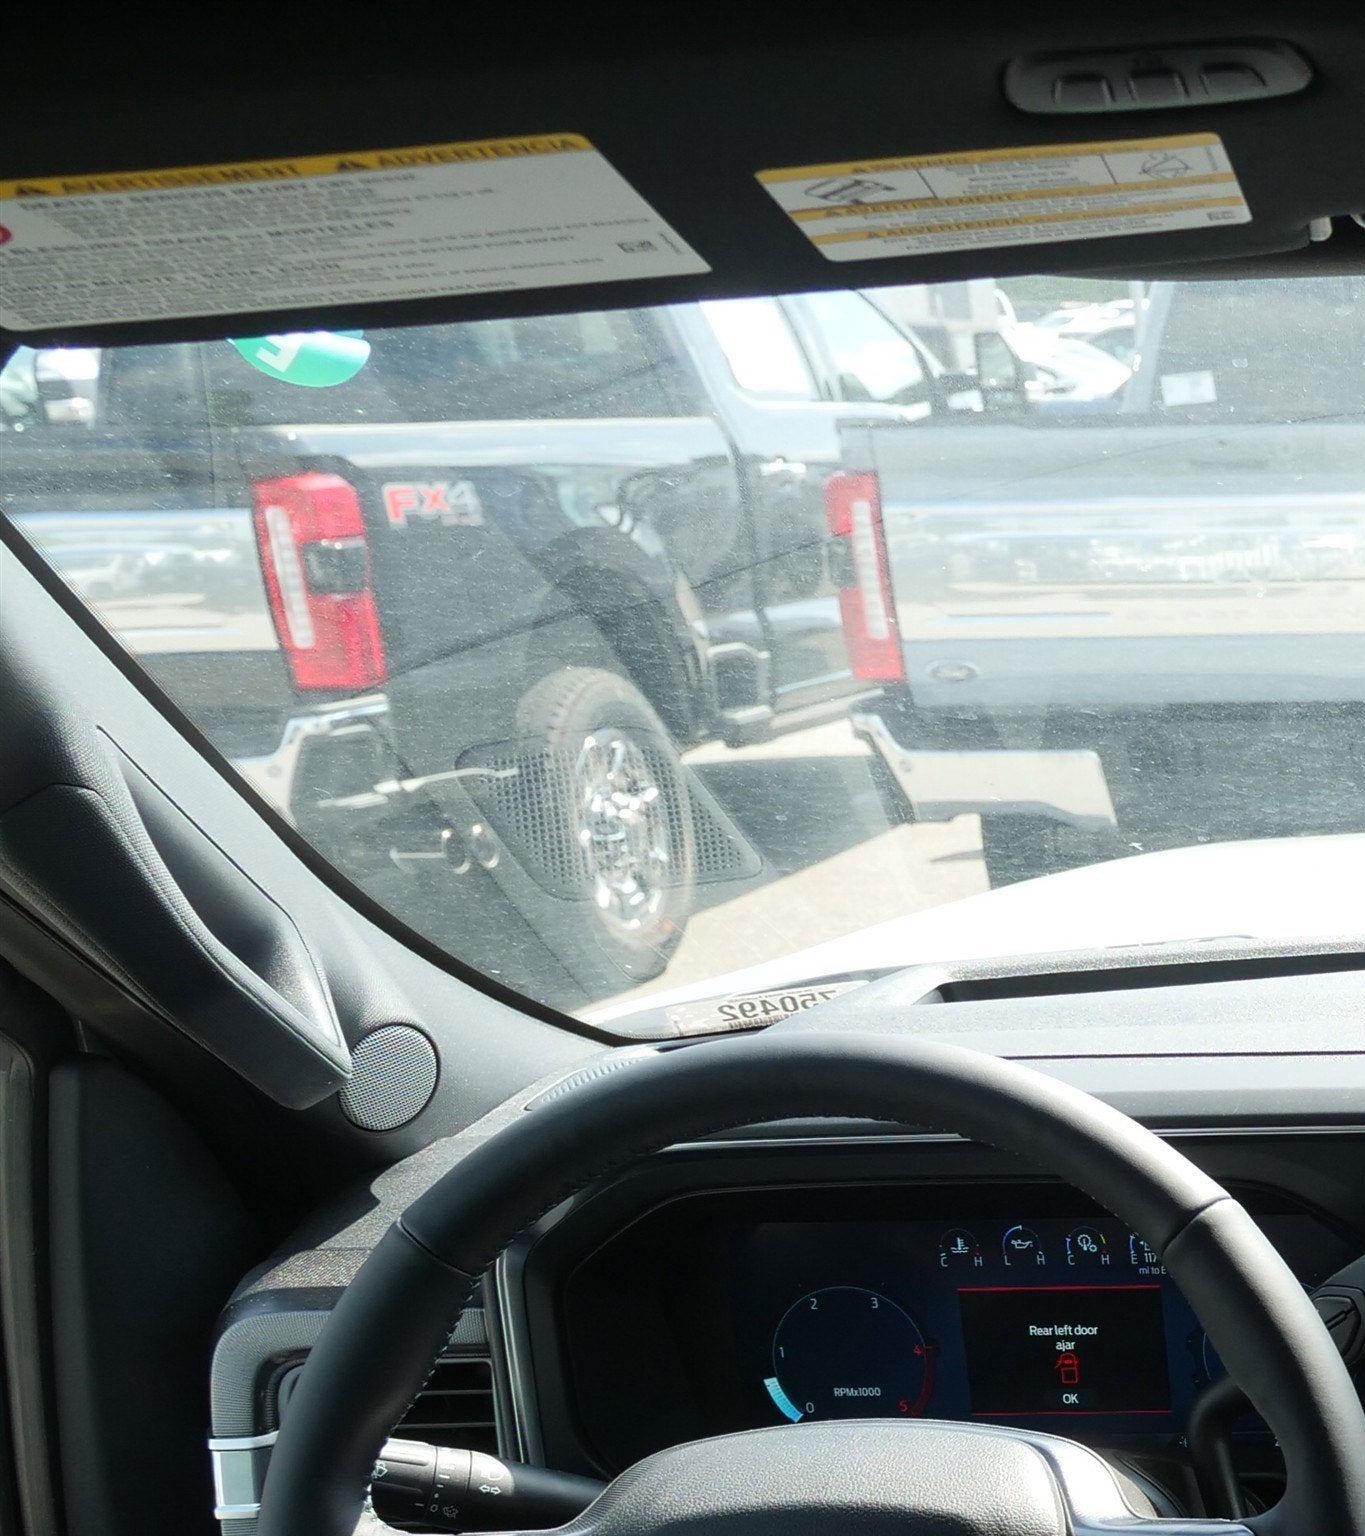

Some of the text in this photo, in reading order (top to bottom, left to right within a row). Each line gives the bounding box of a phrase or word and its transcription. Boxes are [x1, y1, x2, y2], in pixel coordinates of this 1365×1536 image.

[382, 481, 483, 528] FX4
[1101, 1254, 1110, 1265] H
[810, 1298, 818, 1310] 2
[870, 1297, 879, 1309] 3
[1028, 1324, 1098, 1336] Rear left door
[1055, 1340, 1076, 1351] ajar
[1062, 1393, 1079, 1404] OK
[805, 1402, 815, 1414] 0
[899, 1401, 908, 1412] 5
